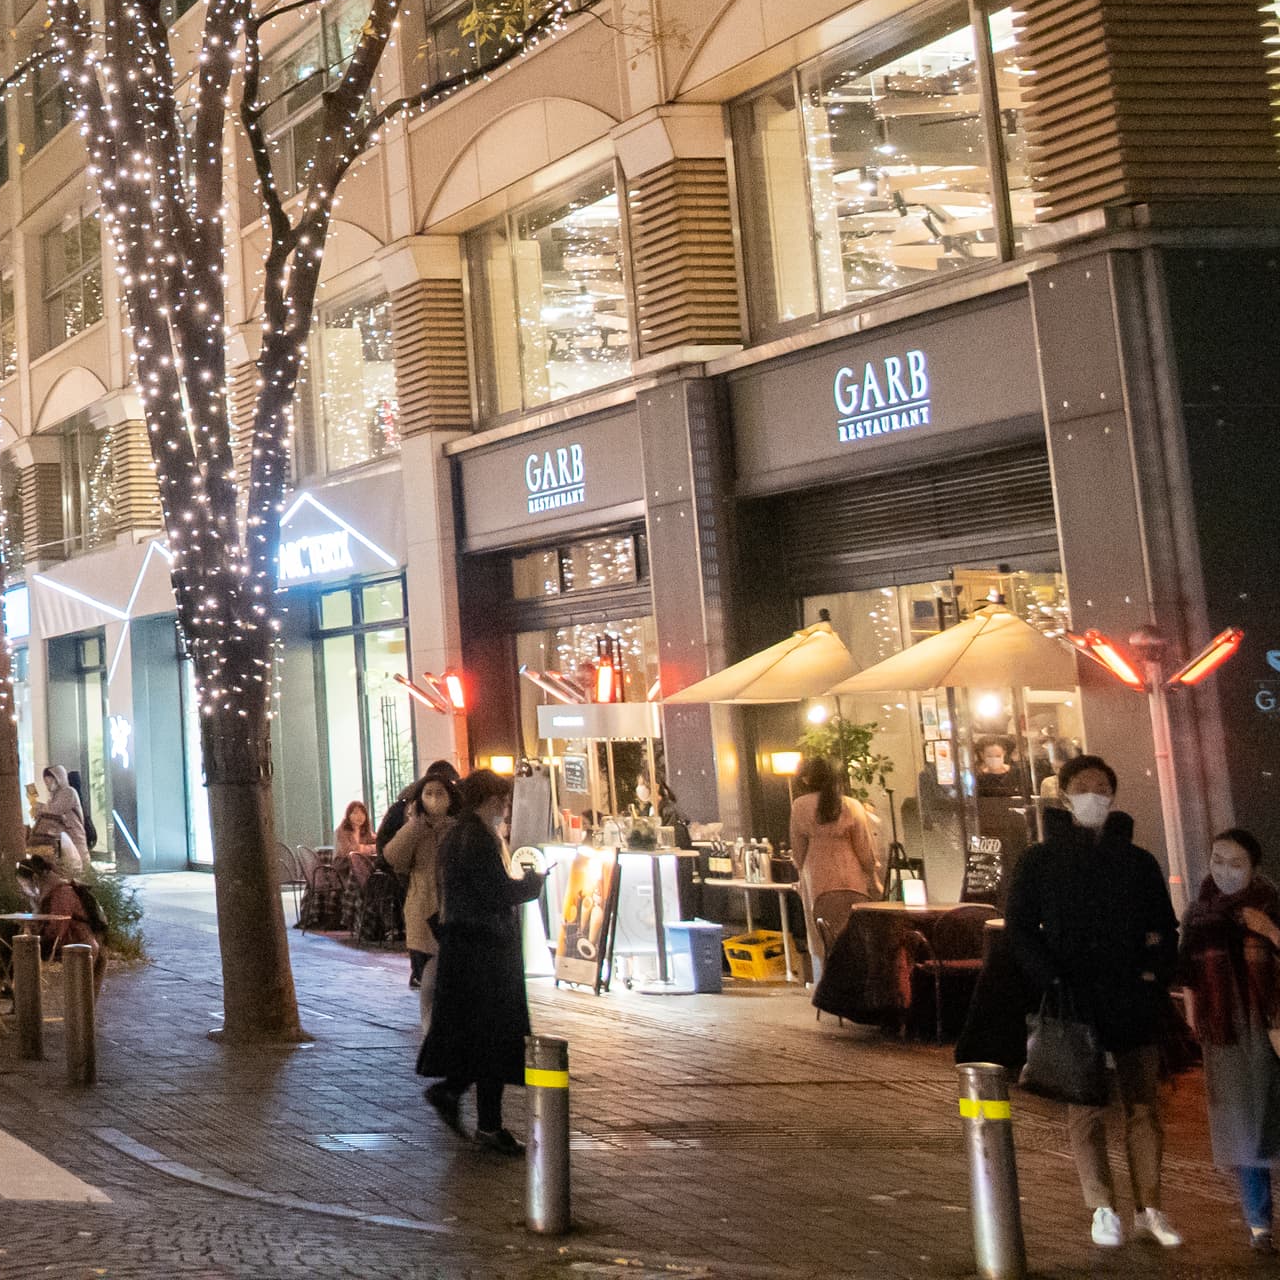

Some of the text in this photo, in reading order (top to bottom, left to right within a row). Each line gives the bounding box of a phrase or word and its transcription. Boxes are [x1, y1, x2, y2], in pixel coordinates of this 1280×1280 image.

[834, 350, 929, 415] GARB
[838, 406, 930, 442] RESTAURANT
[525, 444, 584, 492] GARB
[528, 488, 585, 514] RESTAURANT
